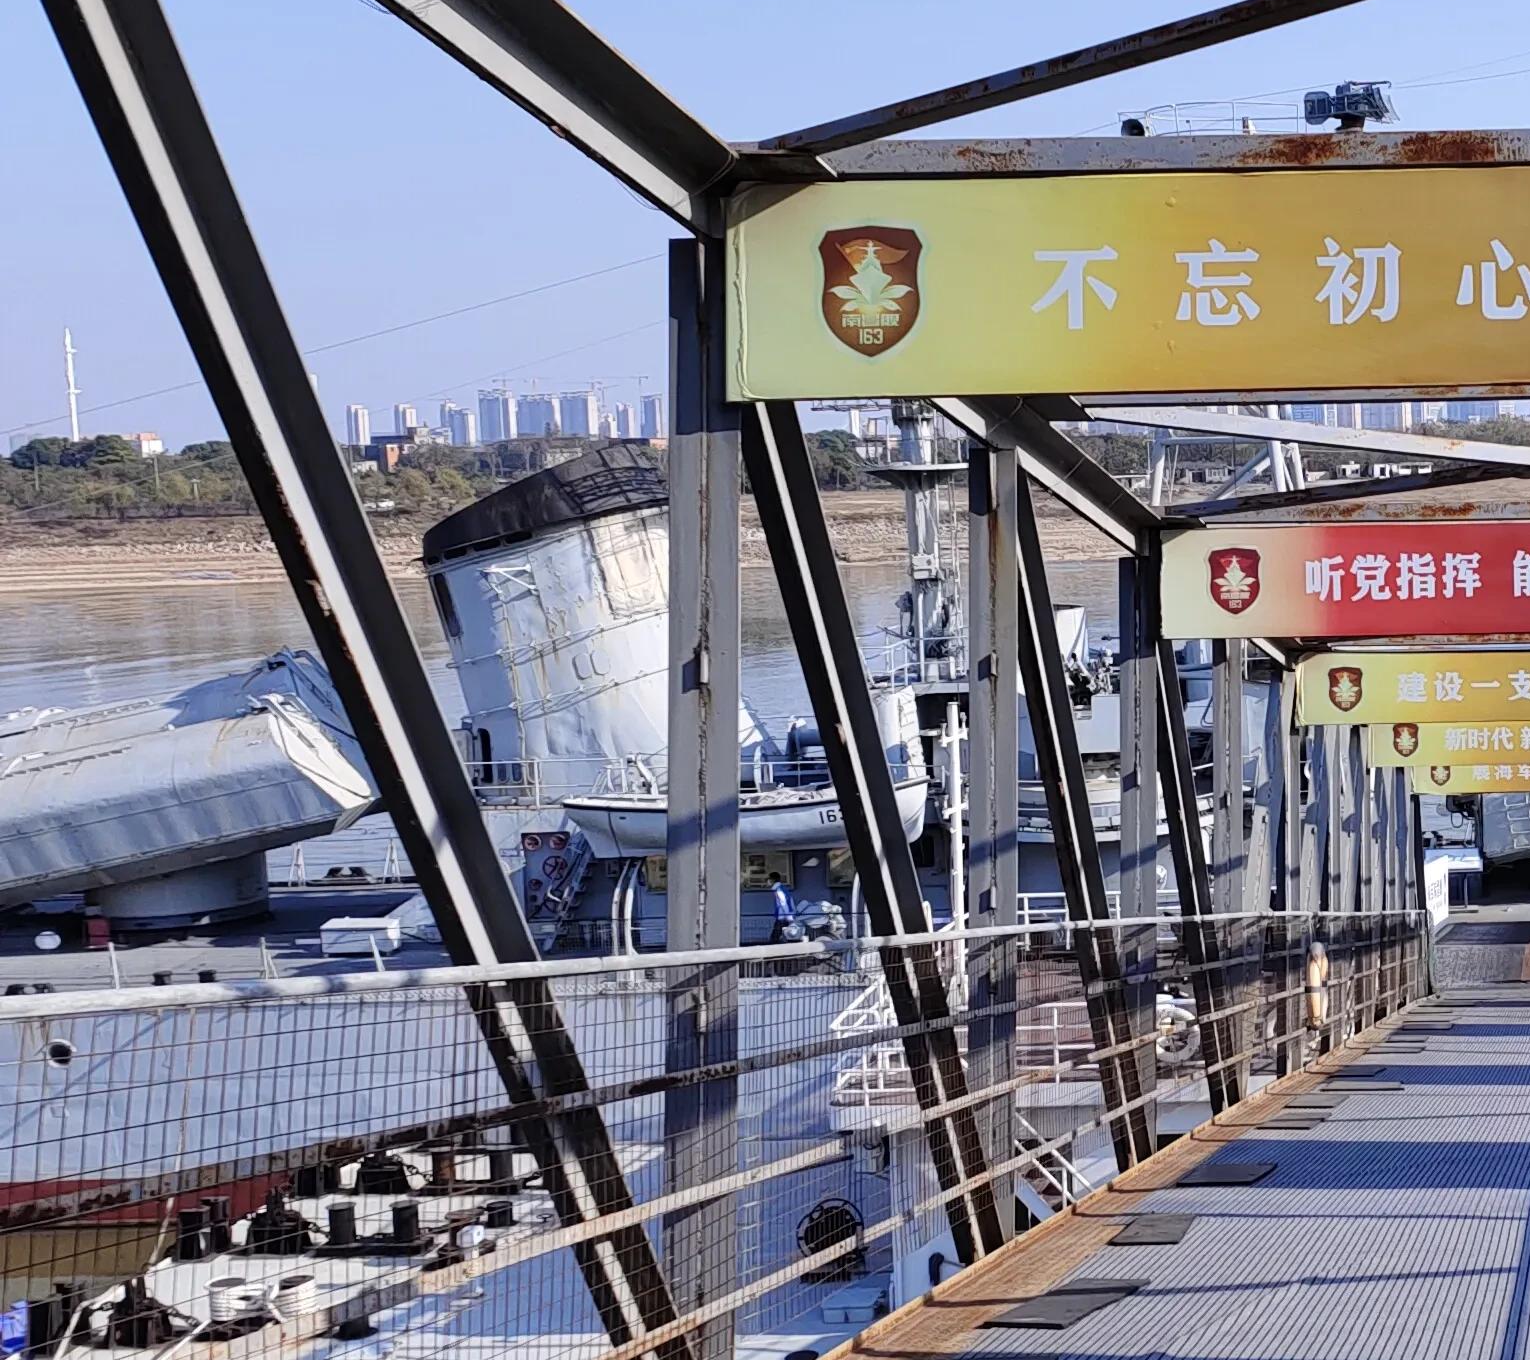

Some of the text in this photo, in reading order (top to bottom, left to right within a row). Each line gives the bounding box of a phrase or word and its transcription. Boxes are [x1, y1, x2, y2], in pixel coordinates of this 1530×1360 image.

[859, 328, 884, 345] 163
[1302, 552, 1482, 602] 听党指挥
[1443, 727, 1514, 750] 新时代
[819, 808, 845, 825] 16
